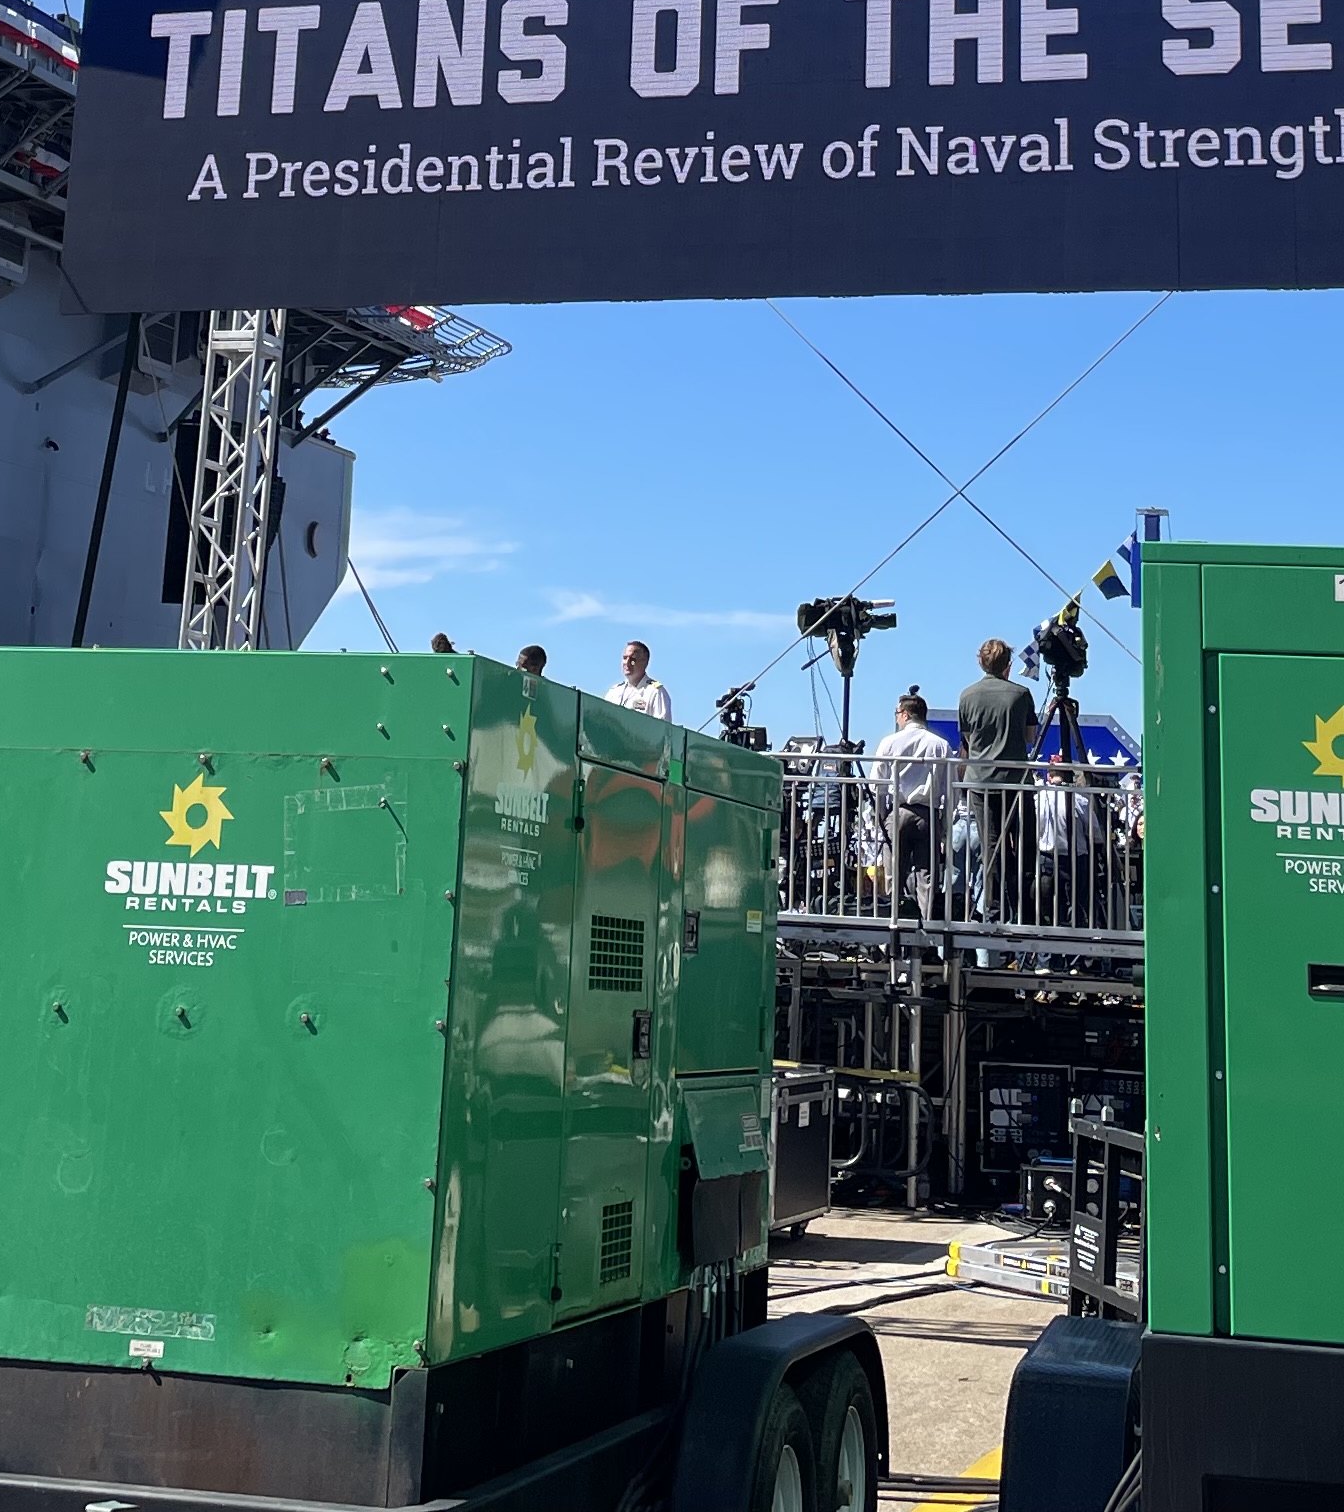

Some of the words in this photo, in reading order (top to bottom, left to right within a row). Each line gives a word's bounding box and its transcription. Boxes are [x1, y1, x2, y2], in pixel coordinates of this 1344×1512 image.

[187, 153, 228, 201] A
[243, 137, 576, 199] Presidential
[592, 131, 805, 188] Review
[822, 124, 880, 180] of
[895, 118, 1074, 177] Naval
[500, 817, 540, 837] RENTALS
[1285, 859, 1342, 877] POWER
[104, 860, 277, 900] SUNBELT
[125, 896, 247, 914] RENTALS
[128, 931, 180, 948] POWER
[182, 934, 194, 948] &
[196, 934, 238, 950] HVAC
[148, 949, 214, 967] SERVICES
